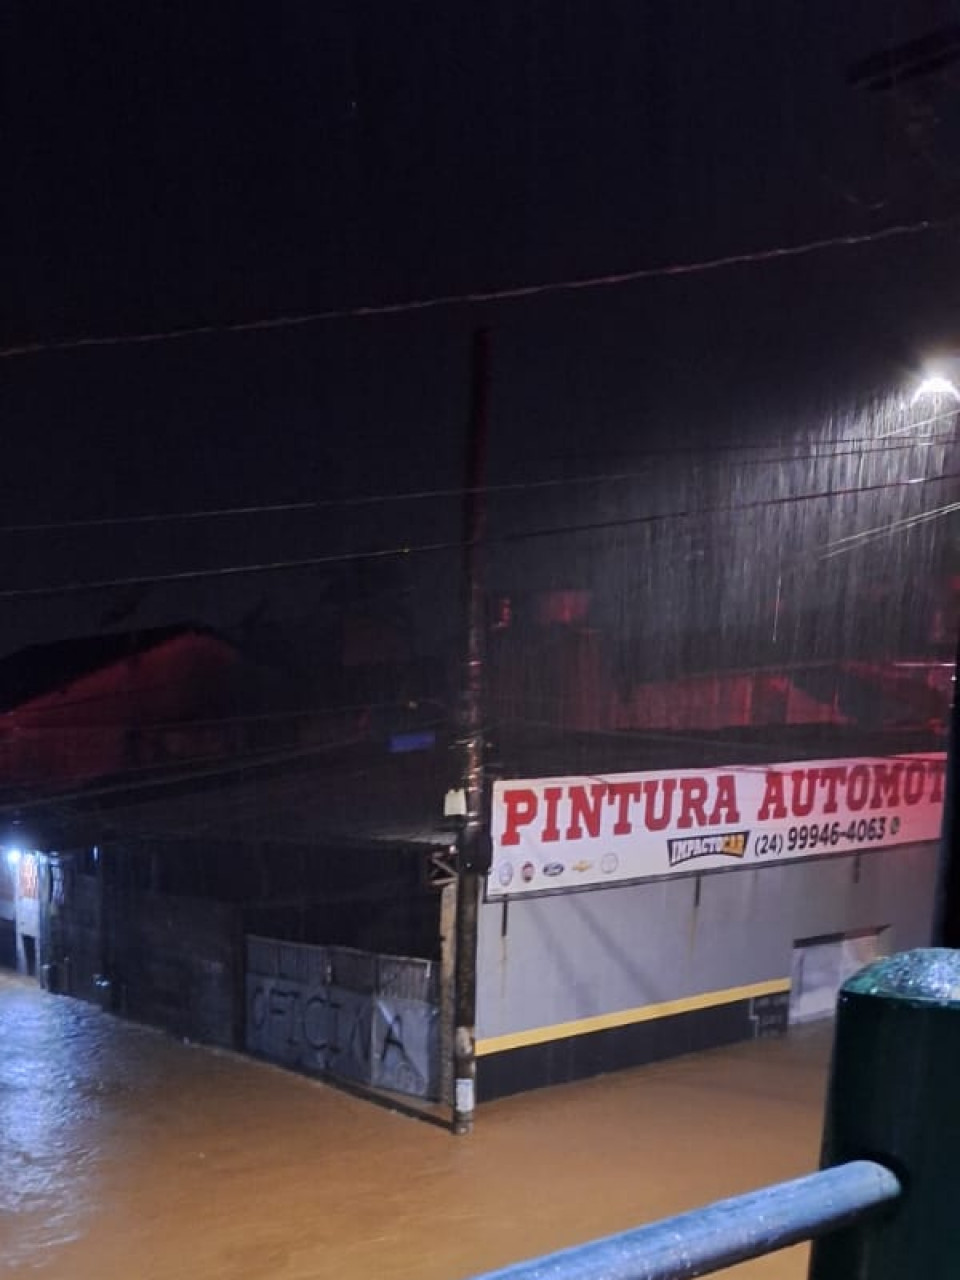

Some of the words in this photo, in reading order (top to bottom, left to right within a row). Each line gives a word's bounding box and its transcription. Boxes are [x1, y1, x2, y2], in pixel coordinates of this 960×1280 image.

[500, 776, 739, 846] PINTURA
[754, 831, 783, 856] (24)
[787, 816, 888, 851] 99946-4063
